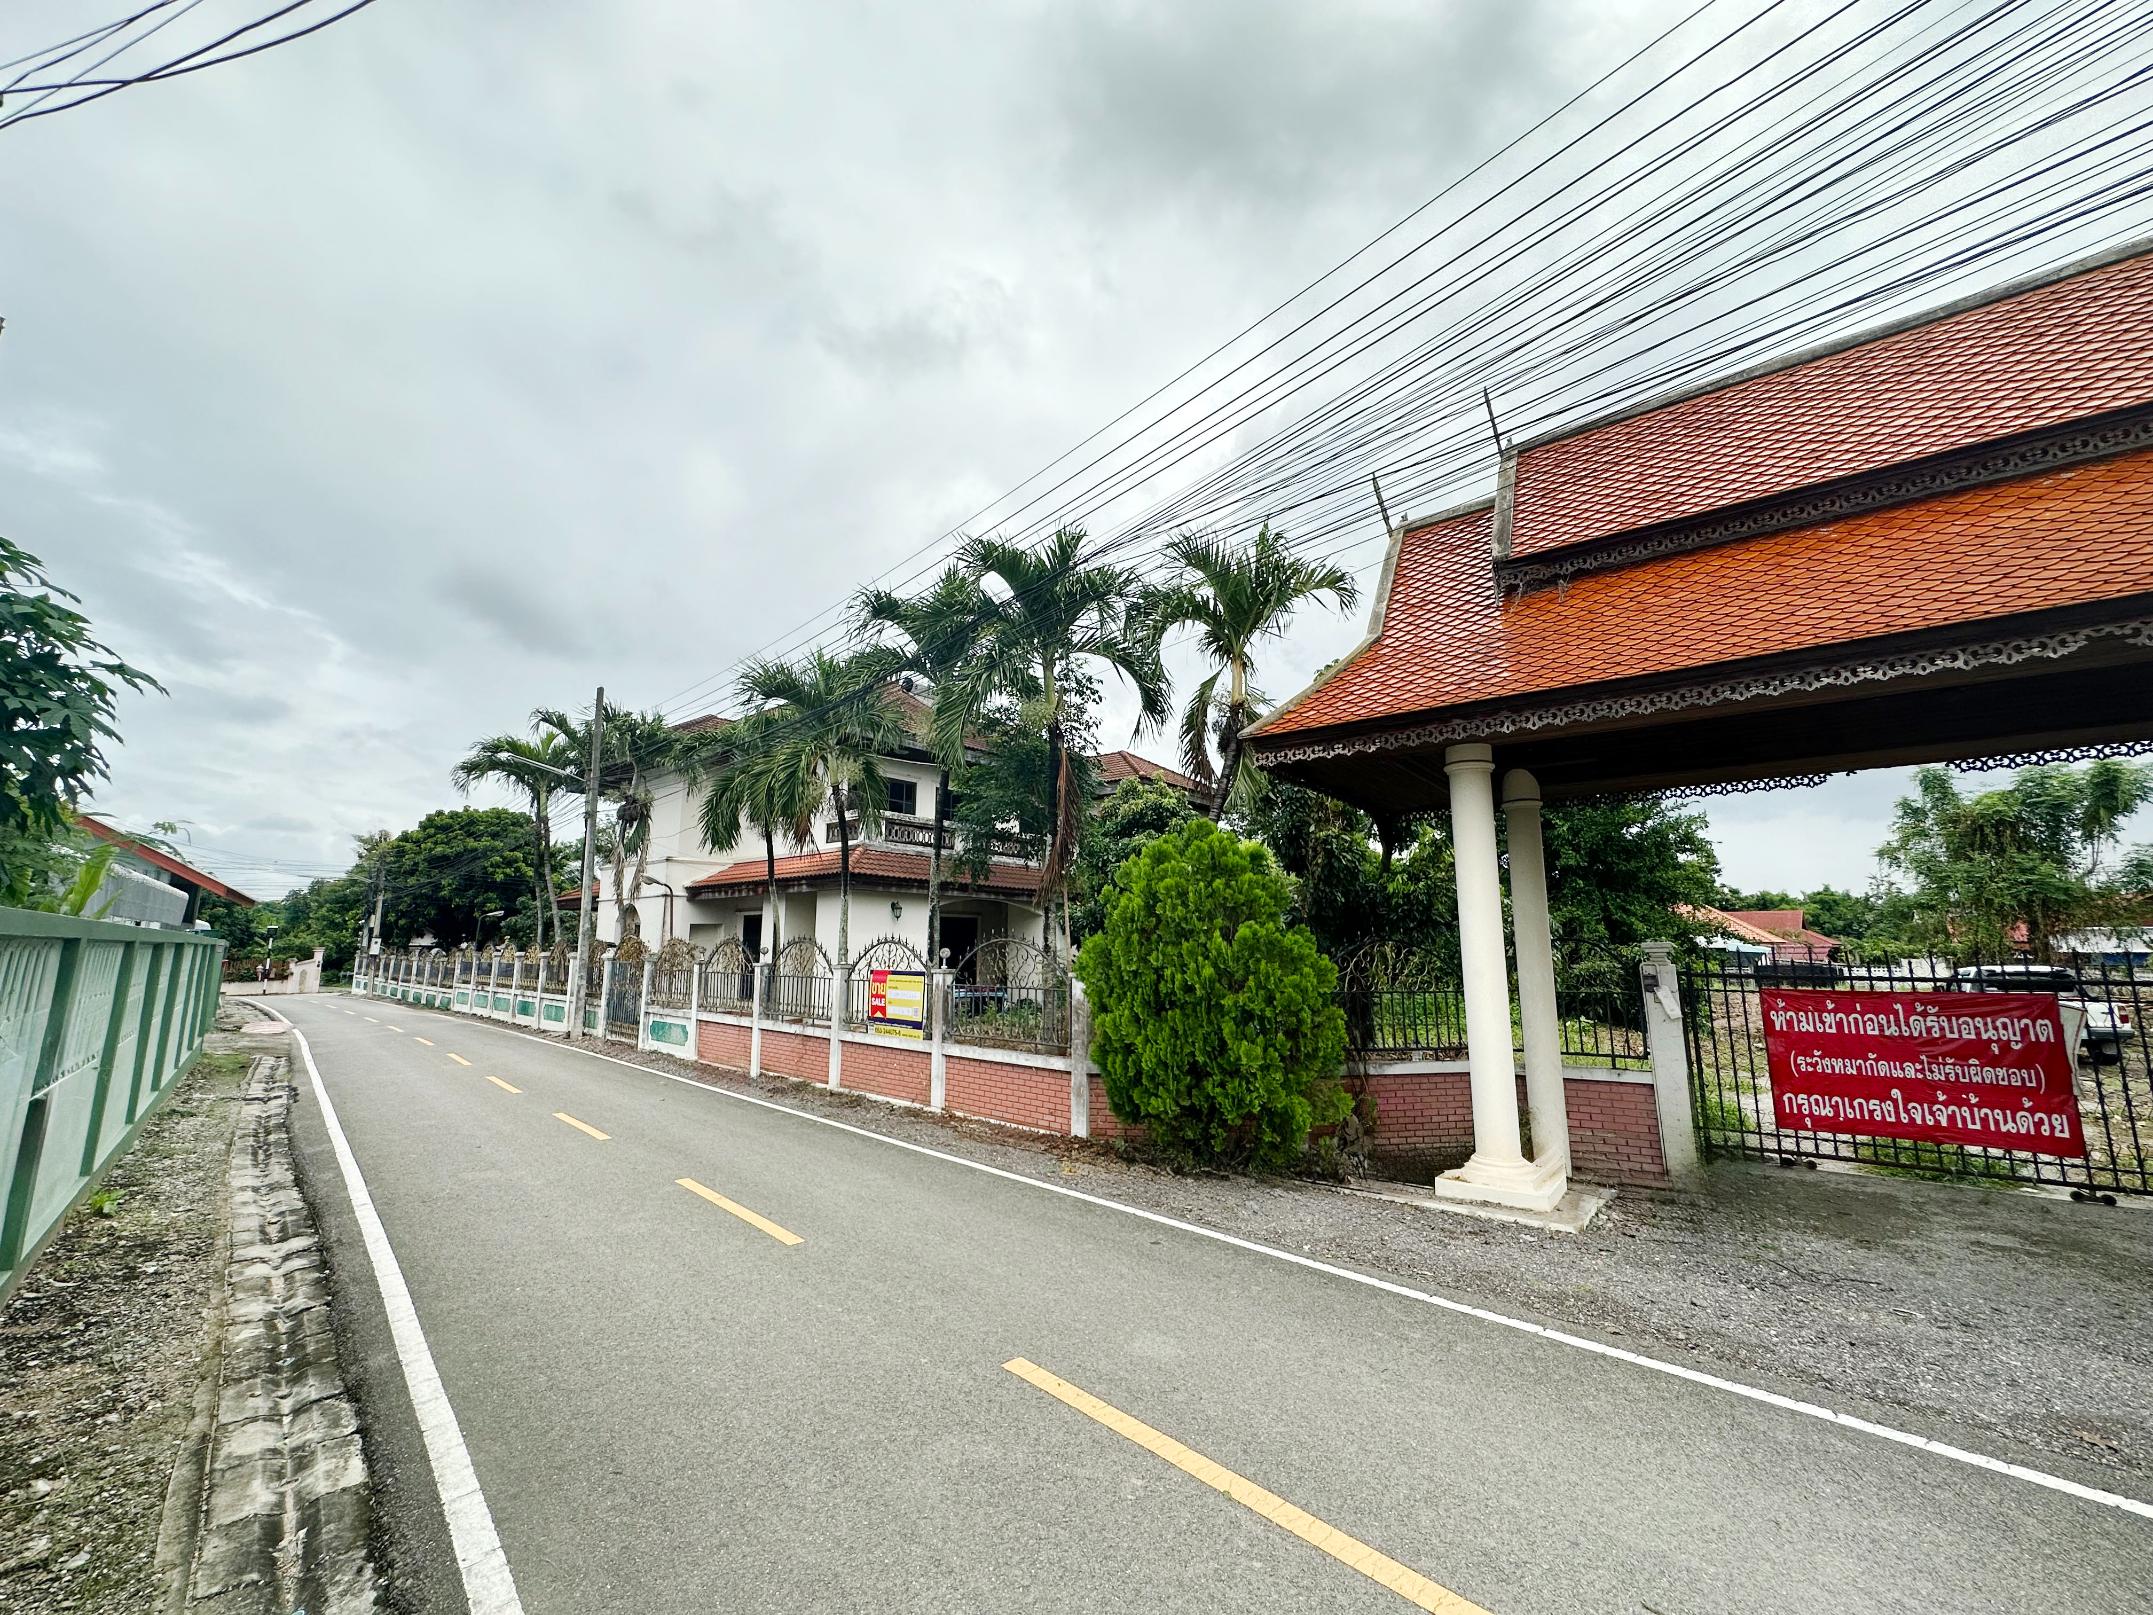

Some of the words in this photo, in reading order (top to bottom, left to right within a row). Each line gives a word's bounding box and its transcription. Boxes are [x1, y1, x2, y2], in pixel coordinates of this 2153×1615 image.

[871, 997, 886, 1006] SALE
[1770, 998, 2055, 1055] ห้ามเข้าก่อนได้รับอนุญาต
[1790, 1050, 2046, 1095] (ระวังหมากัดและไม่รับผิดชอบ)
[1782, 1088, 2071, 1138] กรุณาเกรงใจเจ้าบ้านด้วย
